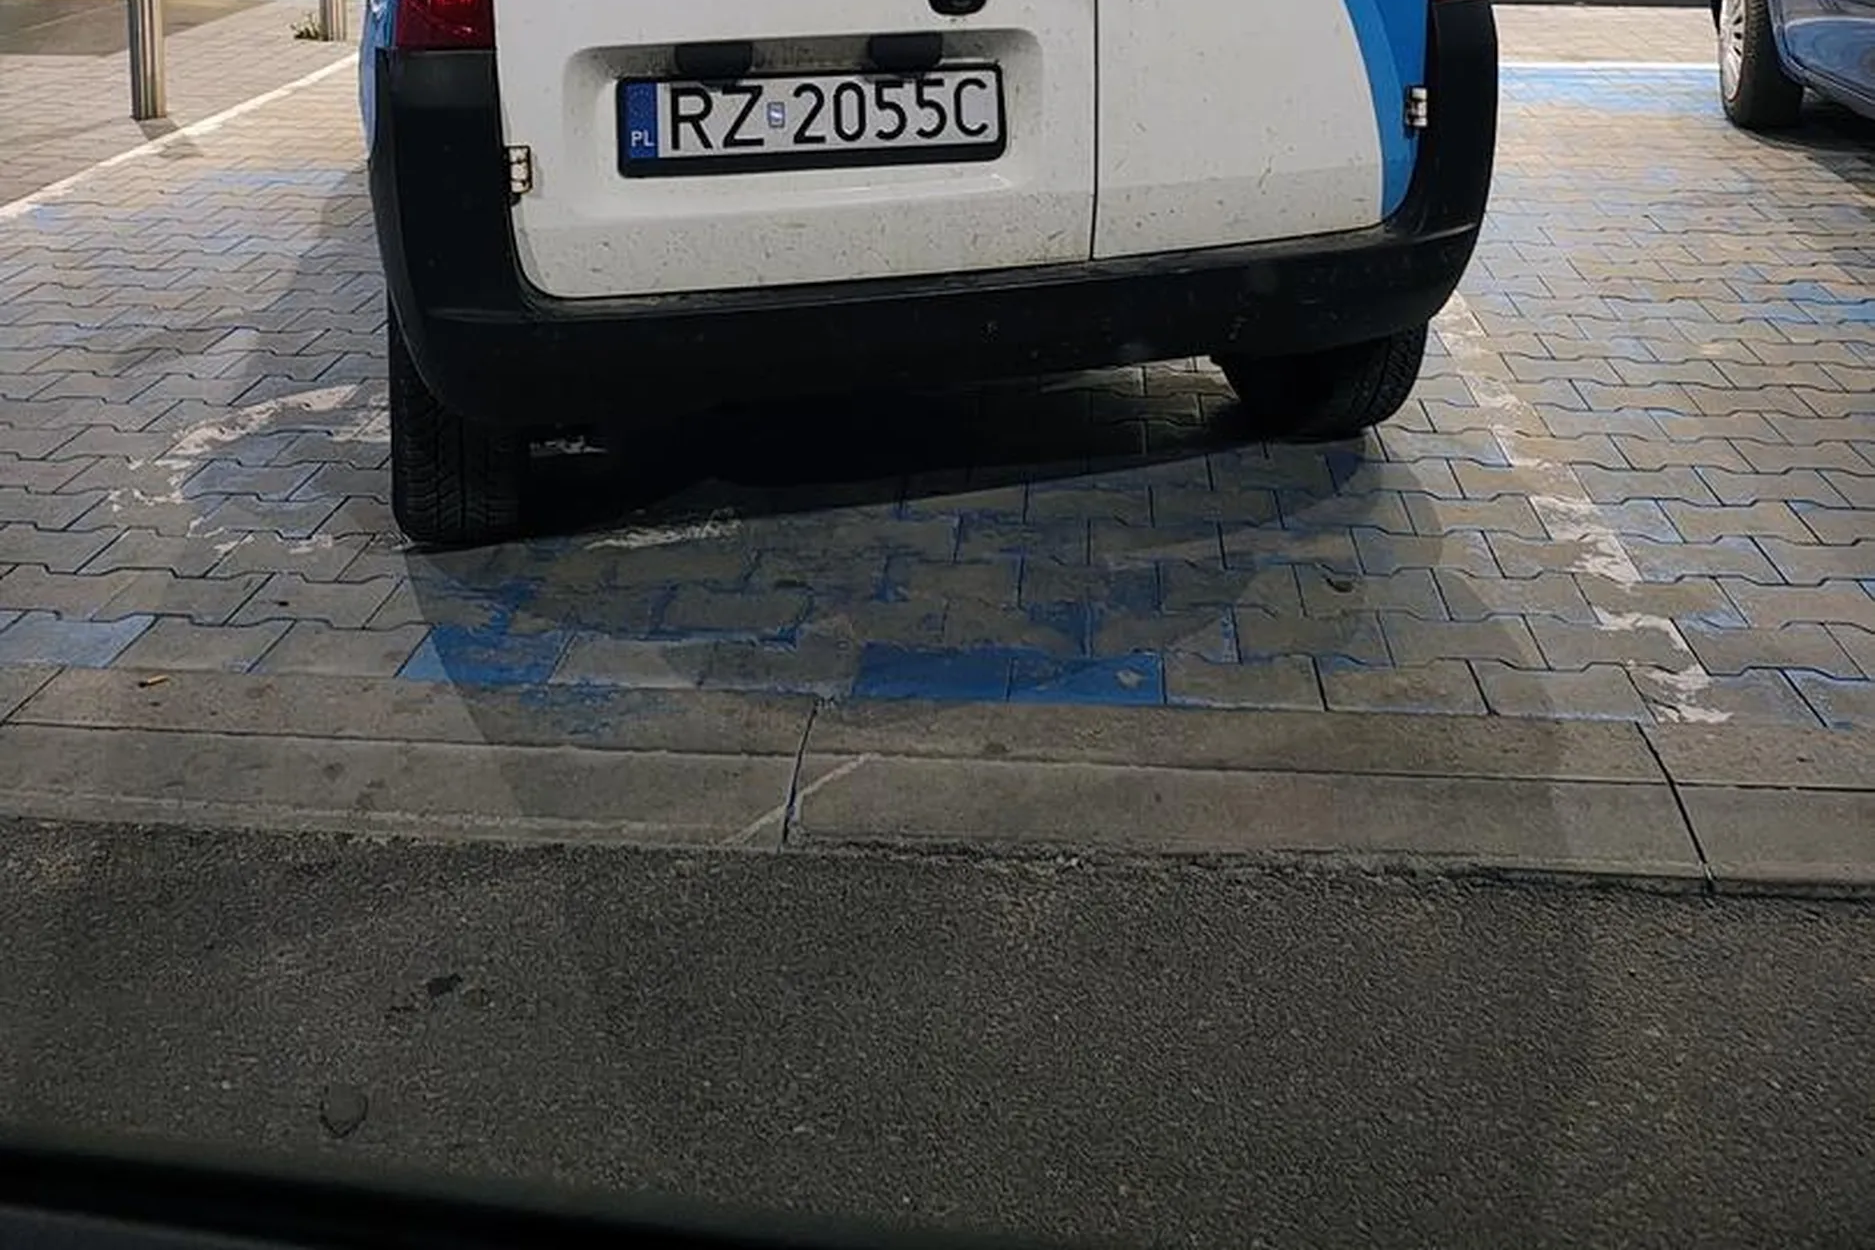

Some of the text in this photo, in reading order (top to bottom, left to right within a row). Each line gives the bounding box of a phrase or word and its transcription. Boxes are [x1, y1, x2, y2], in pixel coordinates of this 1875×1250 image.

[669, 77, 989, 150] RZ 2055C
[631, 131, 656, 148] PL
